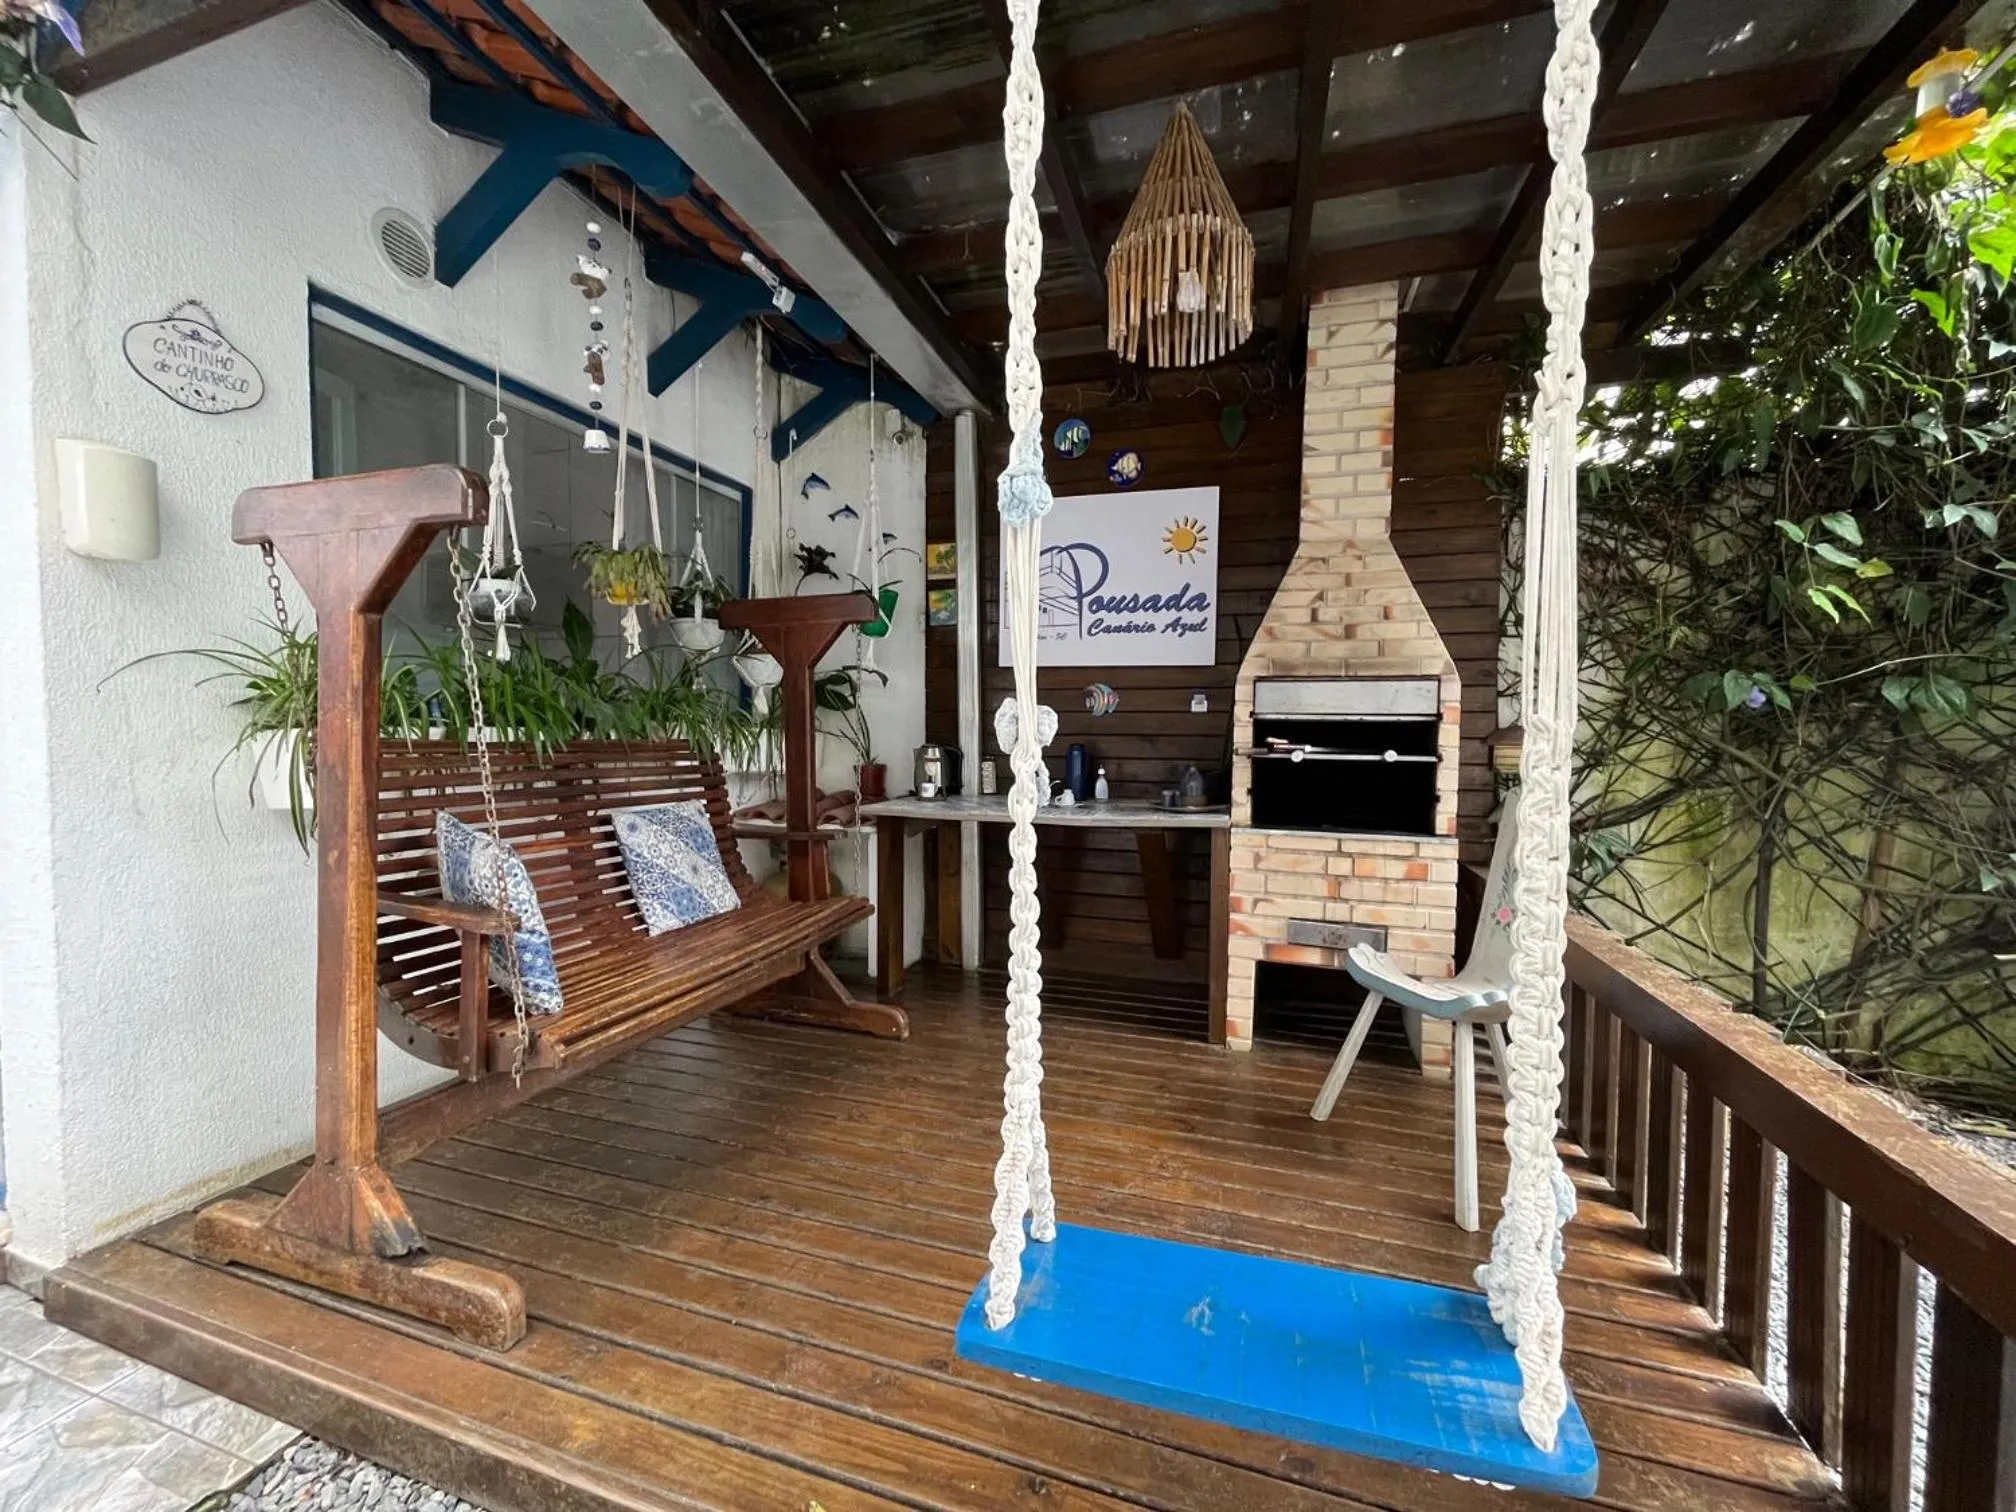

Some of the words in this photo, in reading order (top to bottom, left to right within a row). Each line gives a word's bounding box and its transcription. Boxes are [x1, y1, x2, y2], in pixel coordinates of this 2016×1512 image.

[153, 337, 235, 372] CANTINHO
[175, 363, 250, 394] CHURRASCO
[1058, 542, 1211, 640] Pousada
[1087, 617, 1156, 637] Canário
[1161, 615, 1208, 638] Azul
